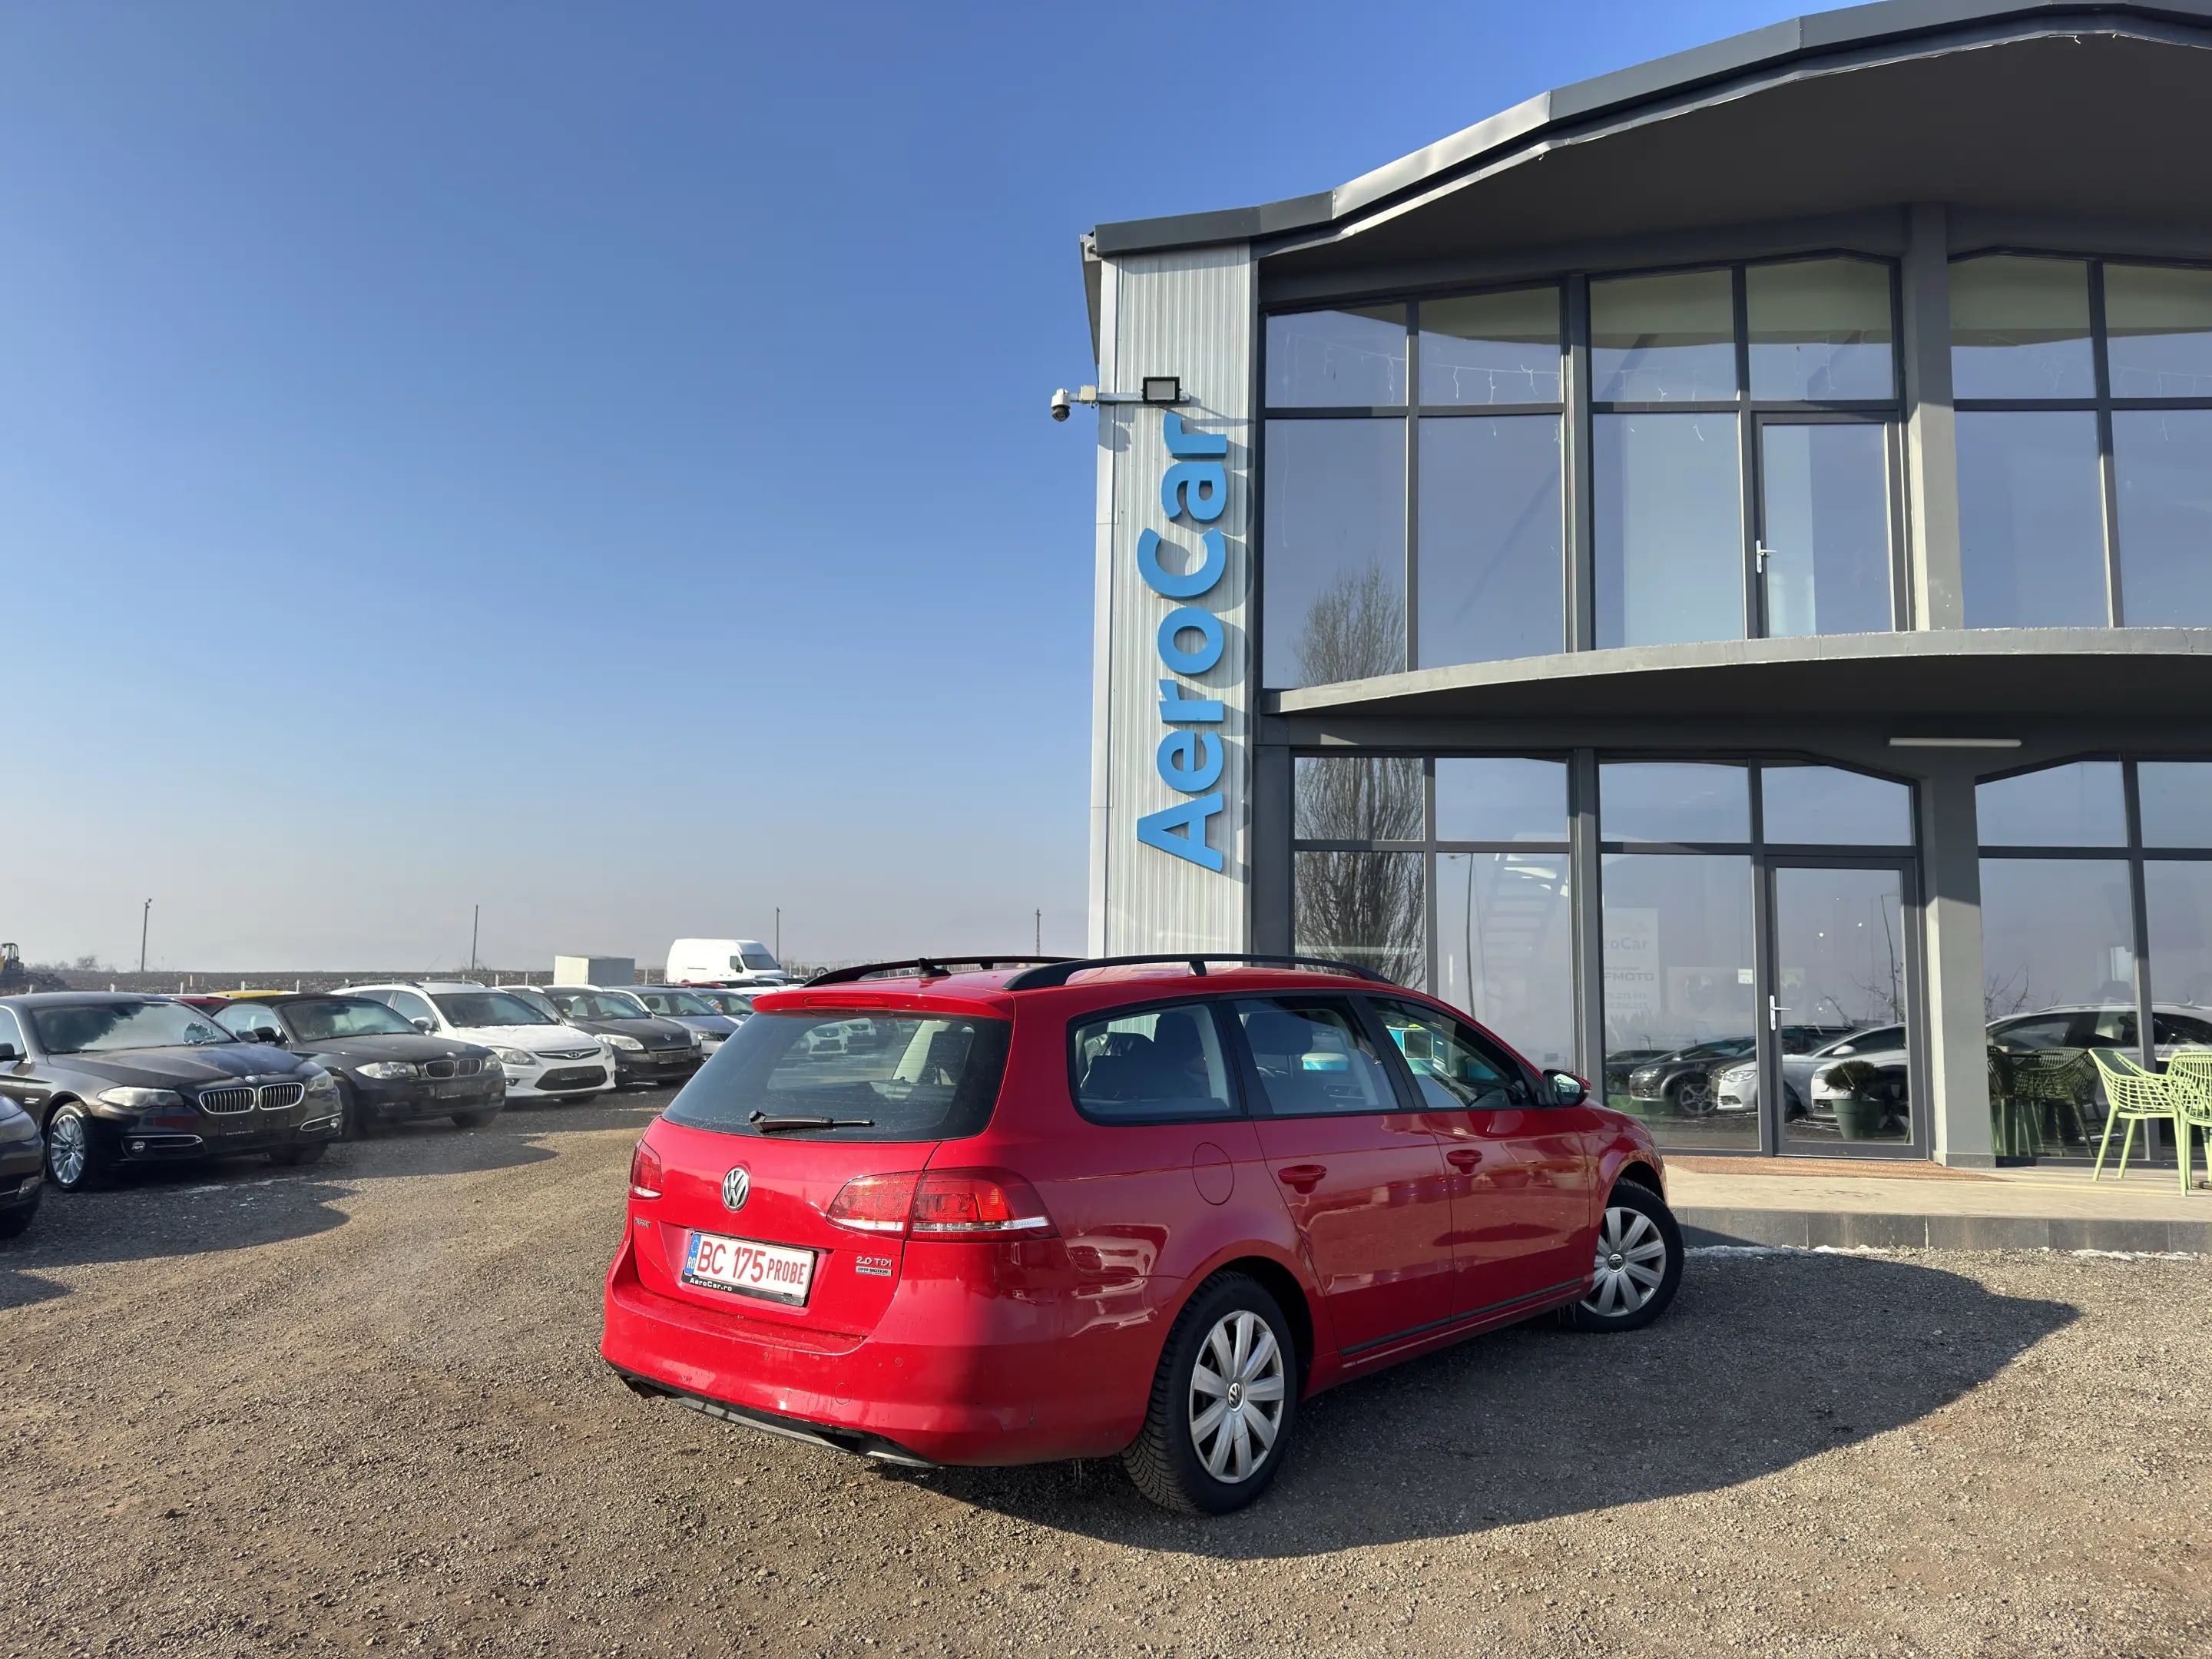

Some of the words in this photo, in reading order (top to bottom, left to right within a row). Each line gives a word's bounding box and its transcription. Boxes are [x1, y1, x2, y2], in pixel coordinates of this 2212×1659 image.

[1137, 413, 1228, 872] AeroCar
[1604, 935, 1648, 951] roCar
[1604, 972, 1654, 982] FMOTO
[686, 1257, 697, 1270] RO
[697, 1240, 727, 1275] BC
[732, 1246, 767, 1283] 175
[767, 1258, 807, 1285] PROBE
[856, 1256, 873, 1265] 2.0
[873, 1257, 892, 1267] TDI
[689, 1277, 733, 1292] AeroCar.ro
